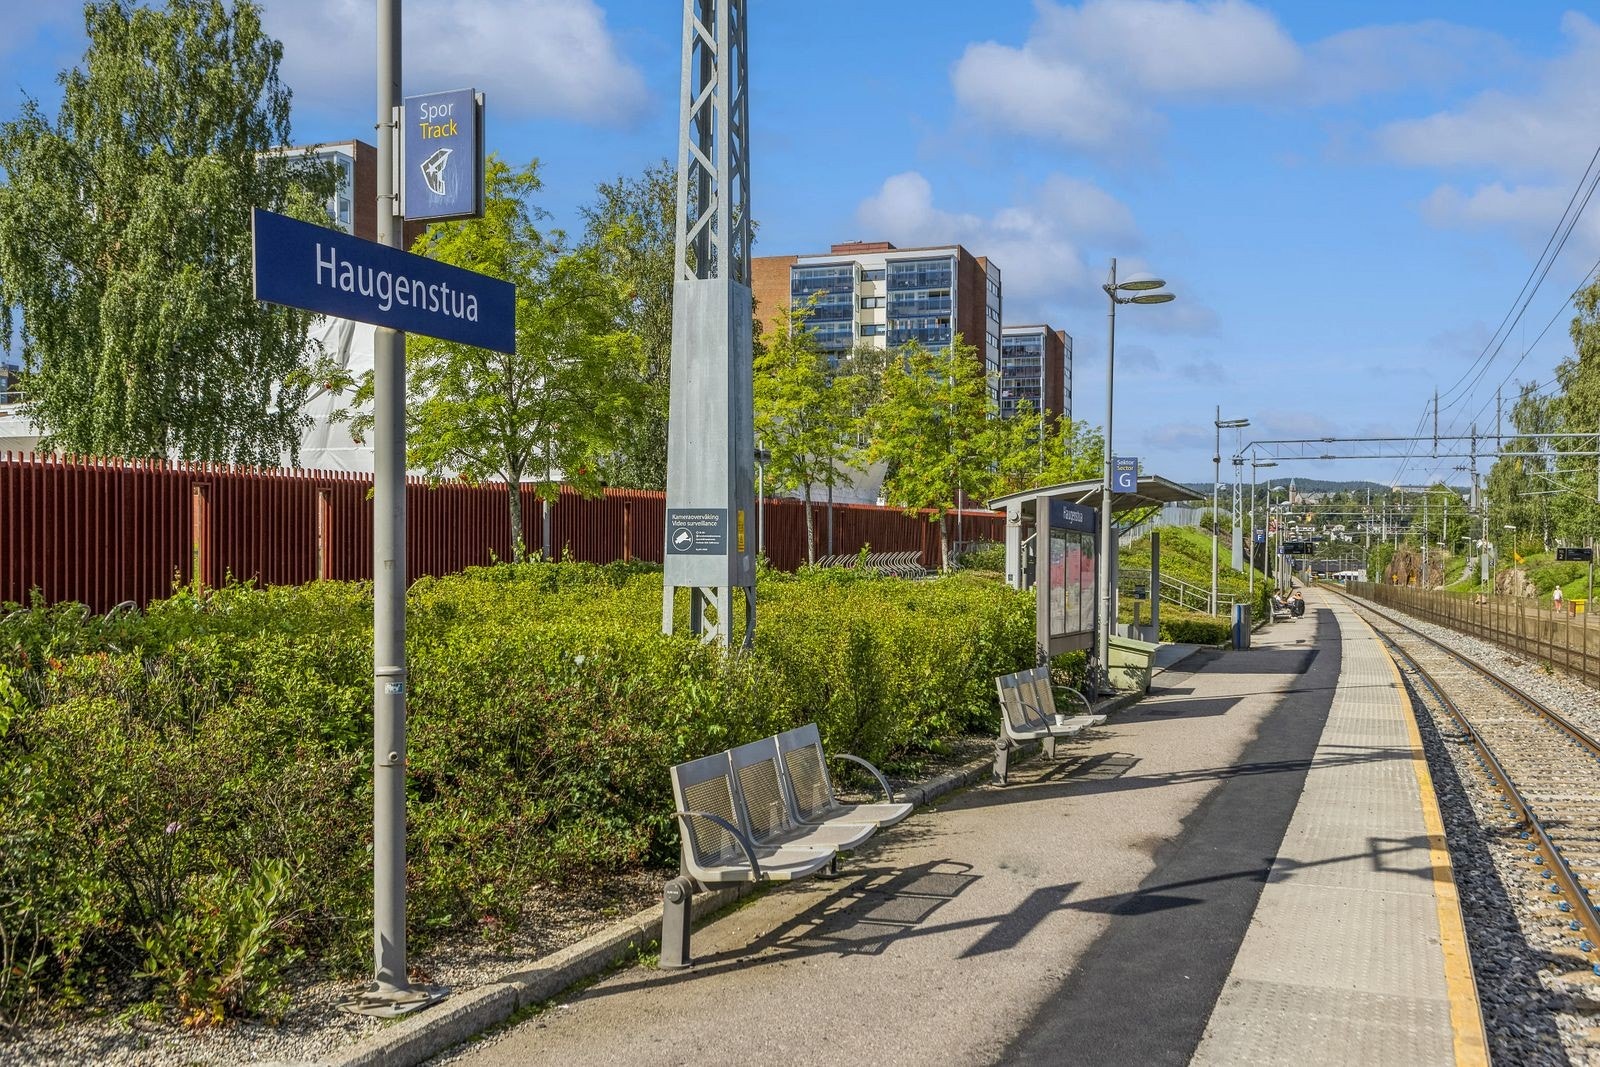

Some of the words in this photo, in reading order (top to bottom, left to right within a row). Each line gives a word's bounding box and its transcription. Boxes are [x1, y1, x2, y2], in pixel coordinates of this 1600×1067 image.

[420, 102, 454, 123] Spor
[419, 118, 458, 139] Track
[315, 242, 479, 322] Haugenstua
[1119, 473, 1131, 488] G
